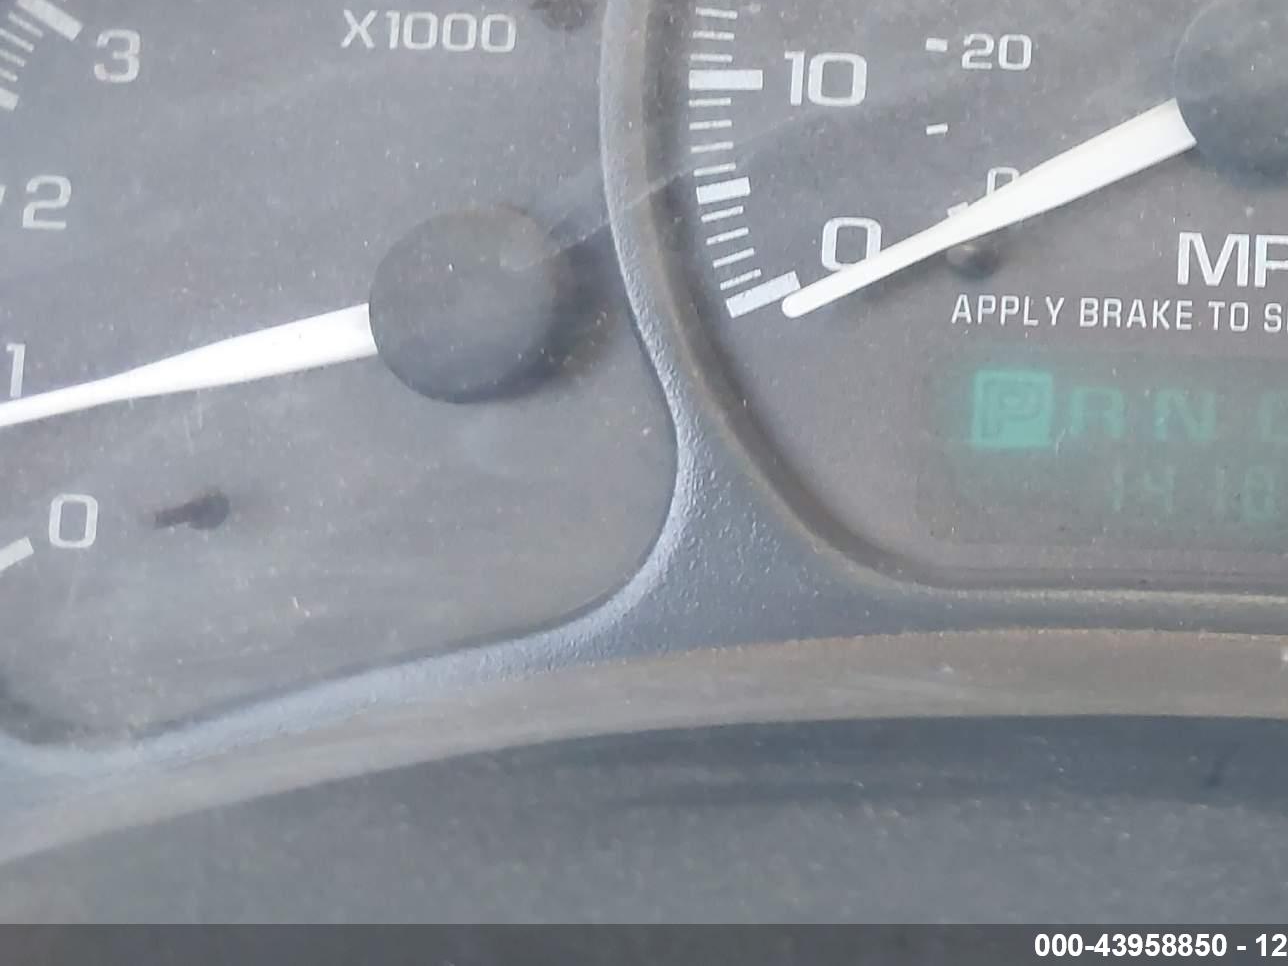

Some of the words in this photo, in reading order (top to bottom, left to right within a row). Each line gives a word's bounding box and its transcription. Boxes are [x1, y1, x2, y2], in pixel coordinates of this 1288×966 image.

[93, 29, 141, 84] 3
[340, 10, 517, 53] X1000
[961, 33, 1033, 72] 20
[784, 49, 868, 108] 10
[22, 174, 72, 231] 2
[821, 216, 882, 272] 0
[951, 293, 1065, 327] APPLY
[1079, 297, 1194, 331] BRAKE
[1207, 300, 1250, 333] TO
[6, 342, 26, 397] 1
[1153, 387, 1218, 443] N
[48, 493, 99, 549] 0
